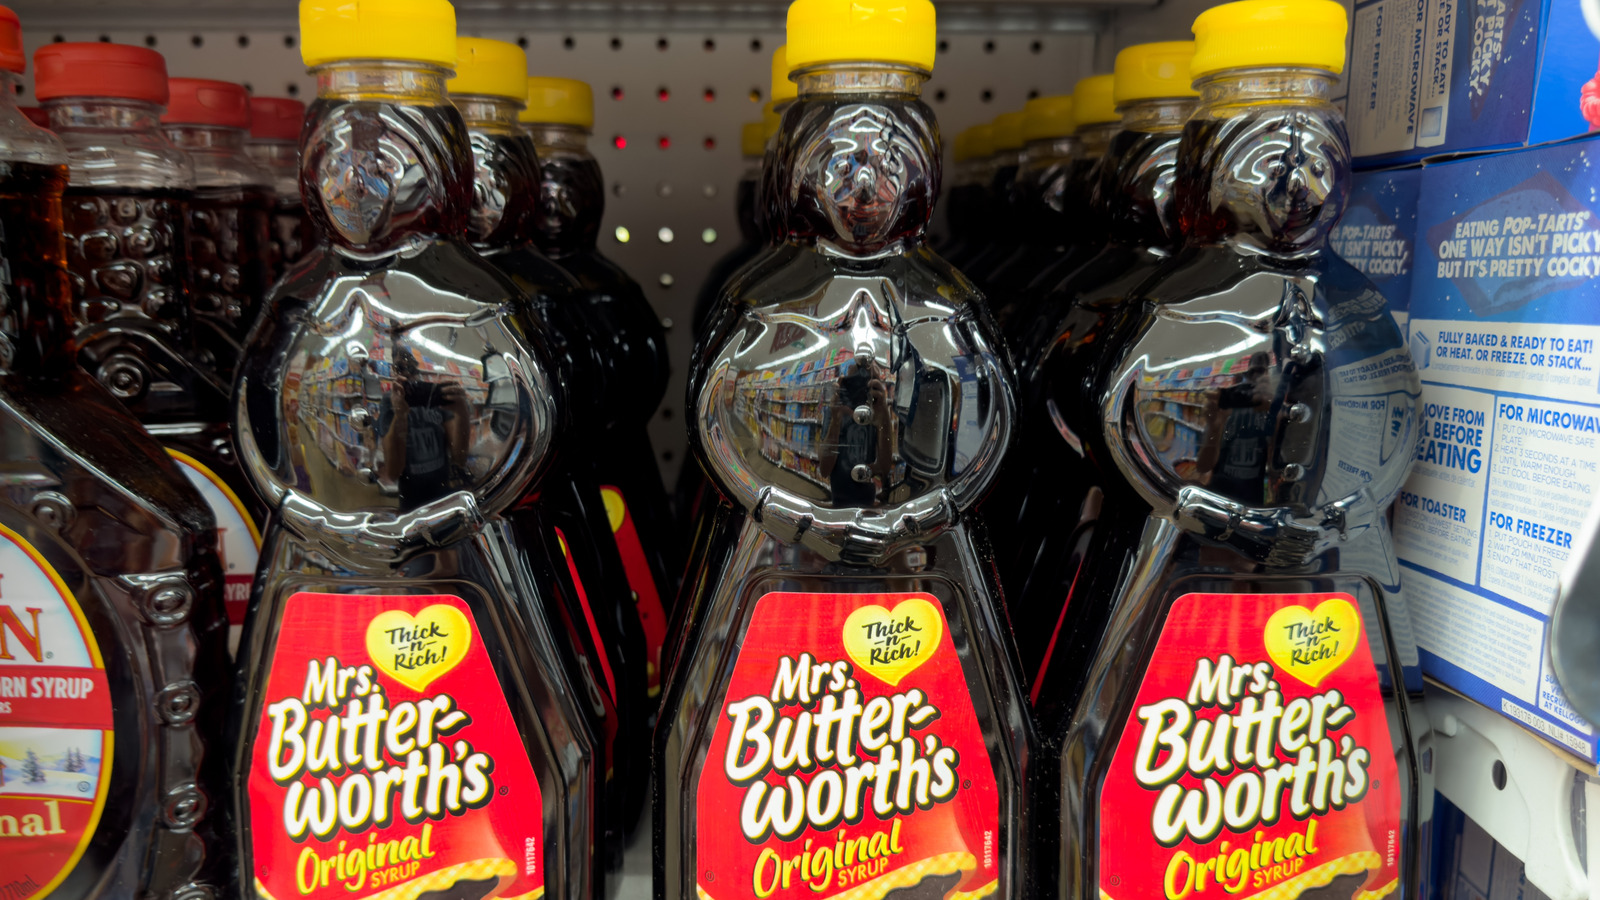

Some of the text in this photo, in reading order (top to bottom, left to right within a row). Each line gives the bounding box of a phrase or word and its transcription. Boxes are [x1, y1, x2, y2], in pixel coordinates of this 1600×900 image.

[1442, 38, 1449, 60] TO
[1406, 28, 1423, 135] MICROWAVE
[1455, 219, 1499, 238] EATING
[1439, 240, 1467, 259] ONE
[1470, 237, 1506, 257] WAY
[1507, 234, 1549, 256] ISN'T
[1437, 260, 1462, 278] BUT
[1464, 259, 1488, 278] IT'S
[1489, 258, 1545, 278] PRETTY
[1438, 331, 1593, 354] FULLY BAKED & READY TO EAT!
[1436, 346, 1592, 371] OR HEAT. OR FREEZE. OR STACK...
[1452, 407, 1485, 427] FROM
[1499, 404, 1523, 421] FOR
[1433, 421, 1483, 447] BEFORE
[1502, 434, 1522, 446] PLATE
[1503, 424, 1516, 434] PUT
[1517, 426, 1528, 435] ON
[1529, 429, 1574, 444] MICROWAVE
[1575, 436, 1595, 448] SAFE
[1501, 445, 1518, 455] HEAT
[1524, 449, 1559, 464] SECONDS
[1499, 466, 1511, 475] LET
[1512, 468, 1530, 480] COOL
[1532, 473, 1561, 487] BEFORE
[1543, 464, 1576, 479] ENOUGH
[1401, 491, 1466, 523] FOR TOASTER
[1489, 511, 1573, 549] FOR FREEZER
[385, 622, 448, 645] Thick
[861, 616, 922, 640] Thick
[1283, 616, 1341, 640] Thick
[394, 646, 448, 671] Rich!
[870, 640, 921, 666] Rich!
[1290, 640, 1339, 666] Rich!
[31, 676, 94, 699] SYRUP
[302, 656, 381, 707] Mrs.
[771, 652, 856, 703] Mrs.
[1186, 654, 1278, 706] Mrs.
[1544, 700, 1553, 711] AT
[267, 692, 469, 781] Butter-
[724, 688, 938, 781] Butter-
[1134, 689, 1356, 785] Butter-
[283, 739, 491, 839] worth's
[741, 734, 957, 840] worth's
[1152, 735, 1370, 843] worth's
[296, 823, 436, 895] Original
[752, 818, 903, 898] Original
[983, 830, 993, 868] 10117642
[1163, 818, 1319, 900] Original
[1386, 829, 1396, 867] 10117642
[370, 862, 421, 889] SYRUP
[837, 857, 889, 887] SYRUP
[1253, 857, 1304, 888] SYRUP
